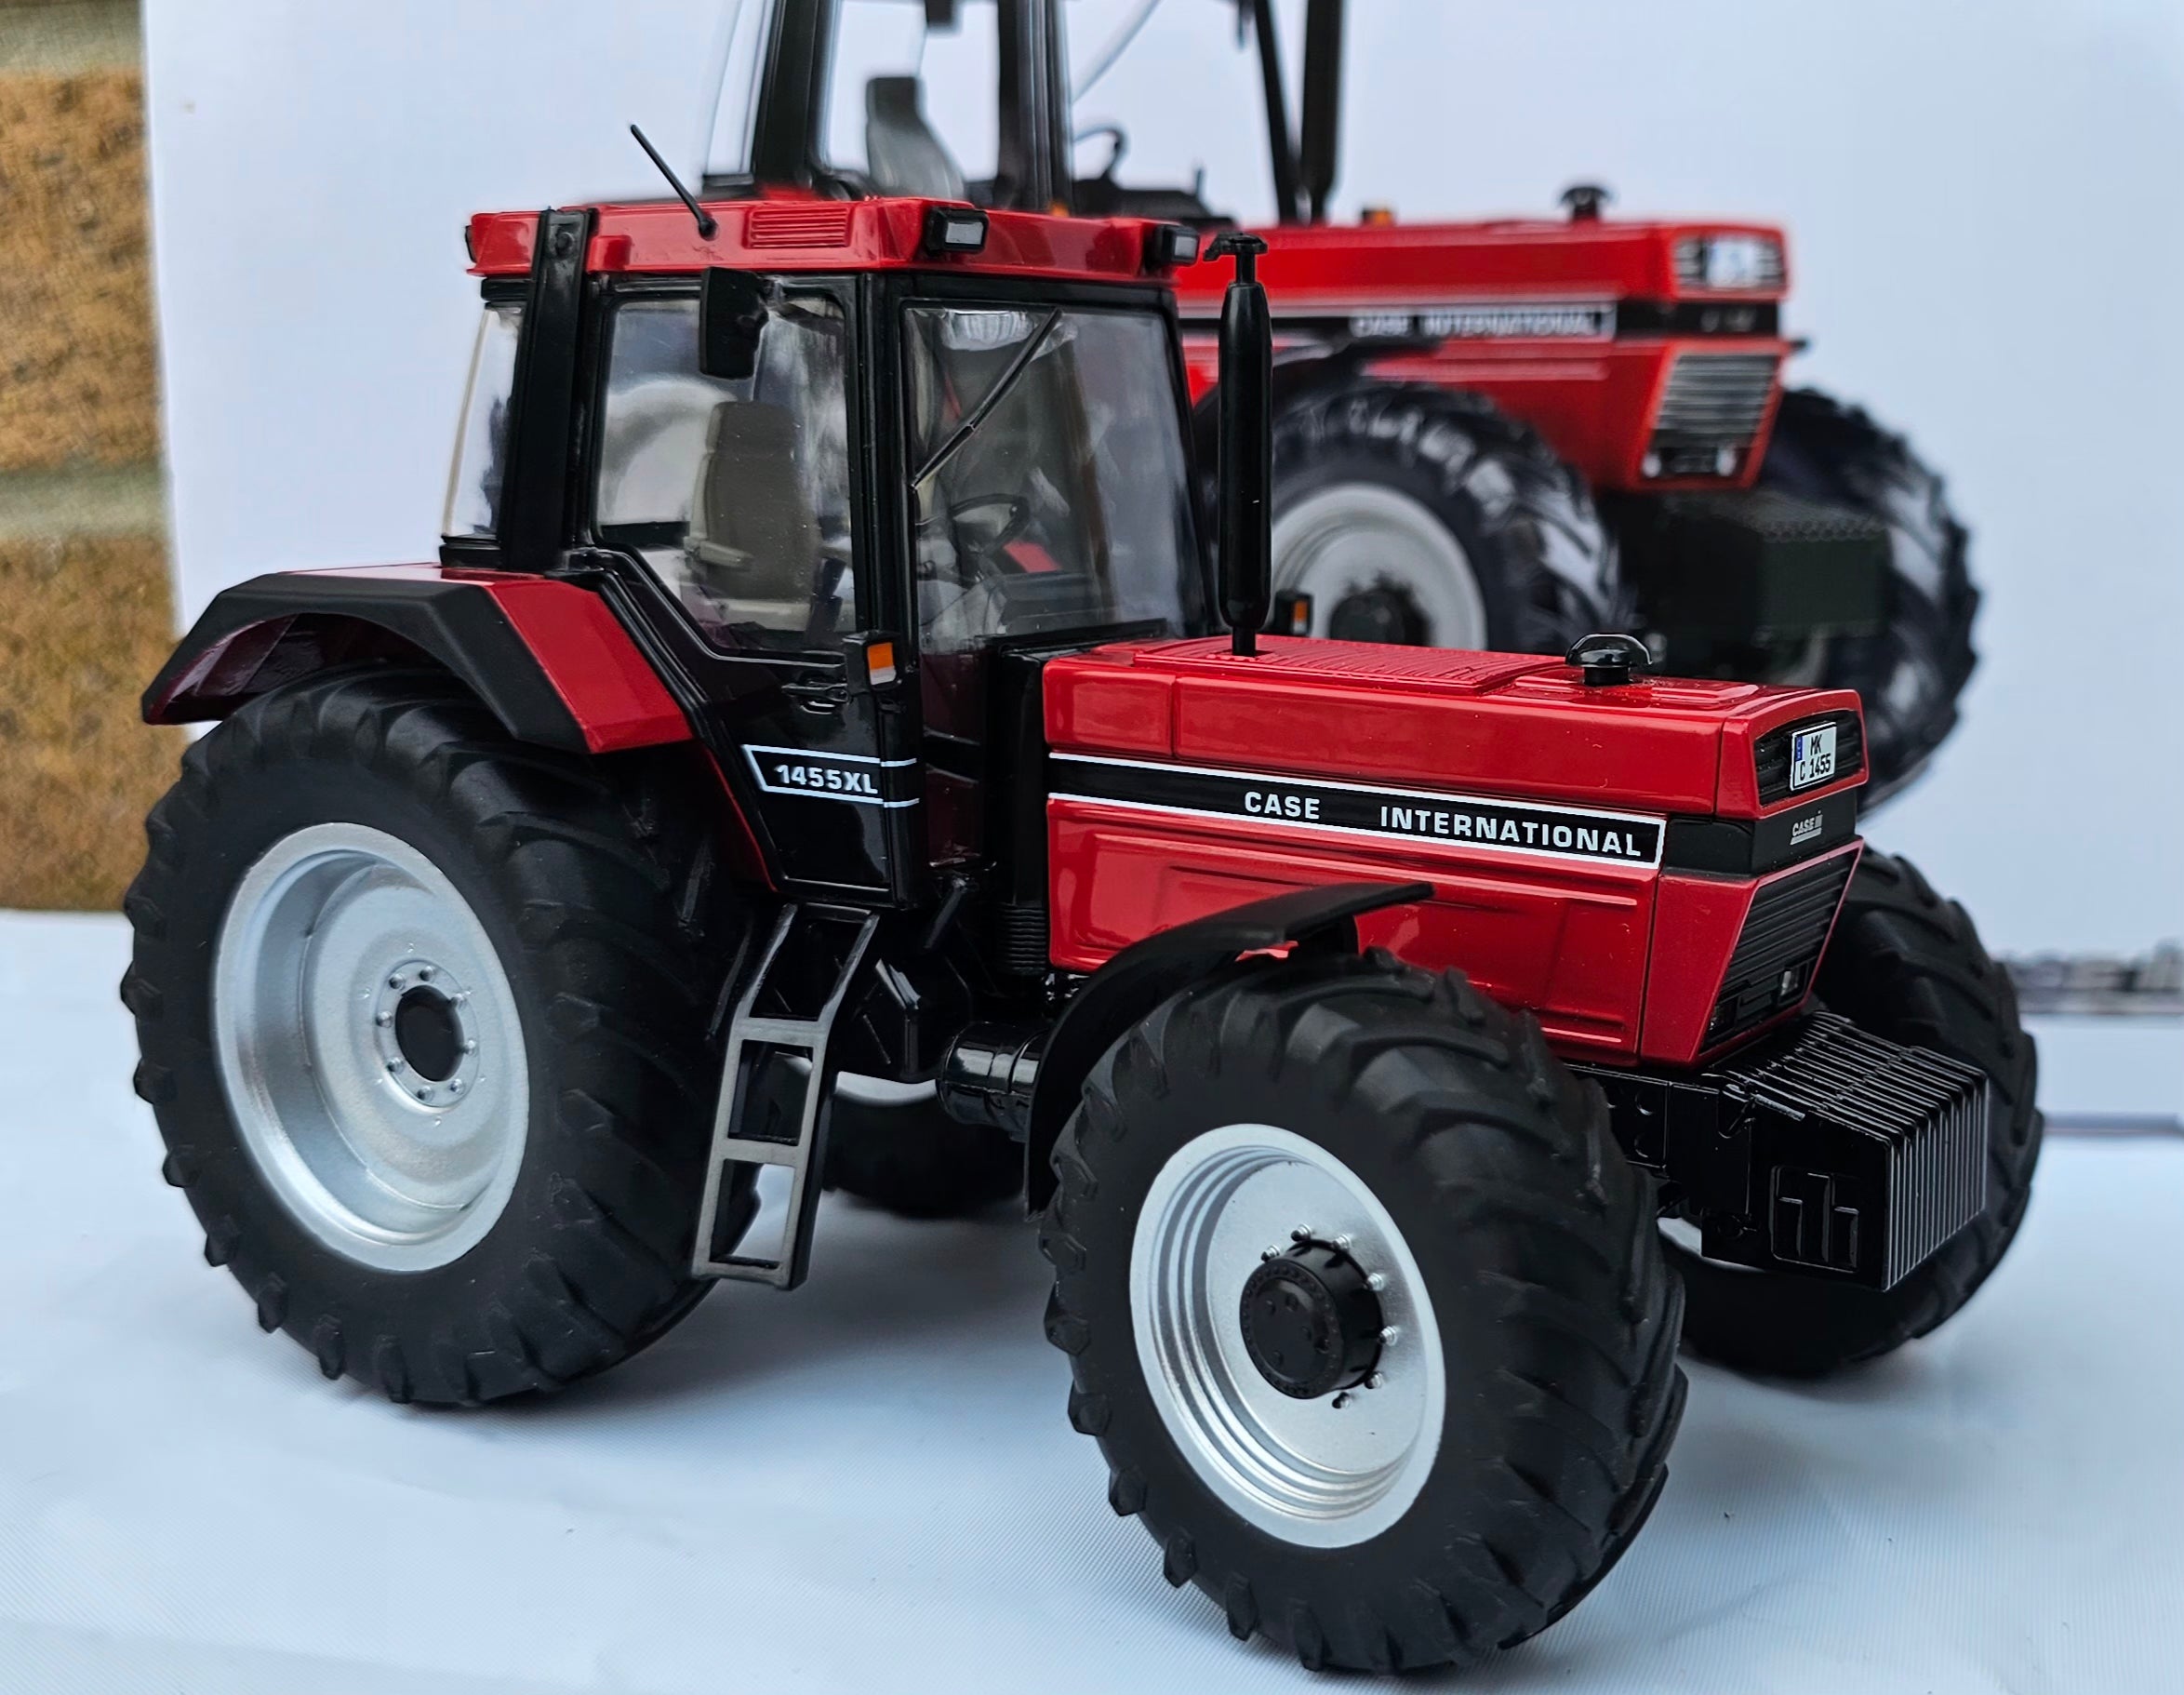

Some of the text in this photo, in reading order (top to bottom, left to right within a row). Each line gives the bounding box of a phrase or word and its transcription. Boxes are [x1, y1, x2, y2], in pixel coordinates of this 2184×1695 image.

[773, 764, 878, 794] 1455XL
[1800, 753, 1831, 781] C 1455
[1245, 791, 1641, 857] CASE INTERNATIONAL
